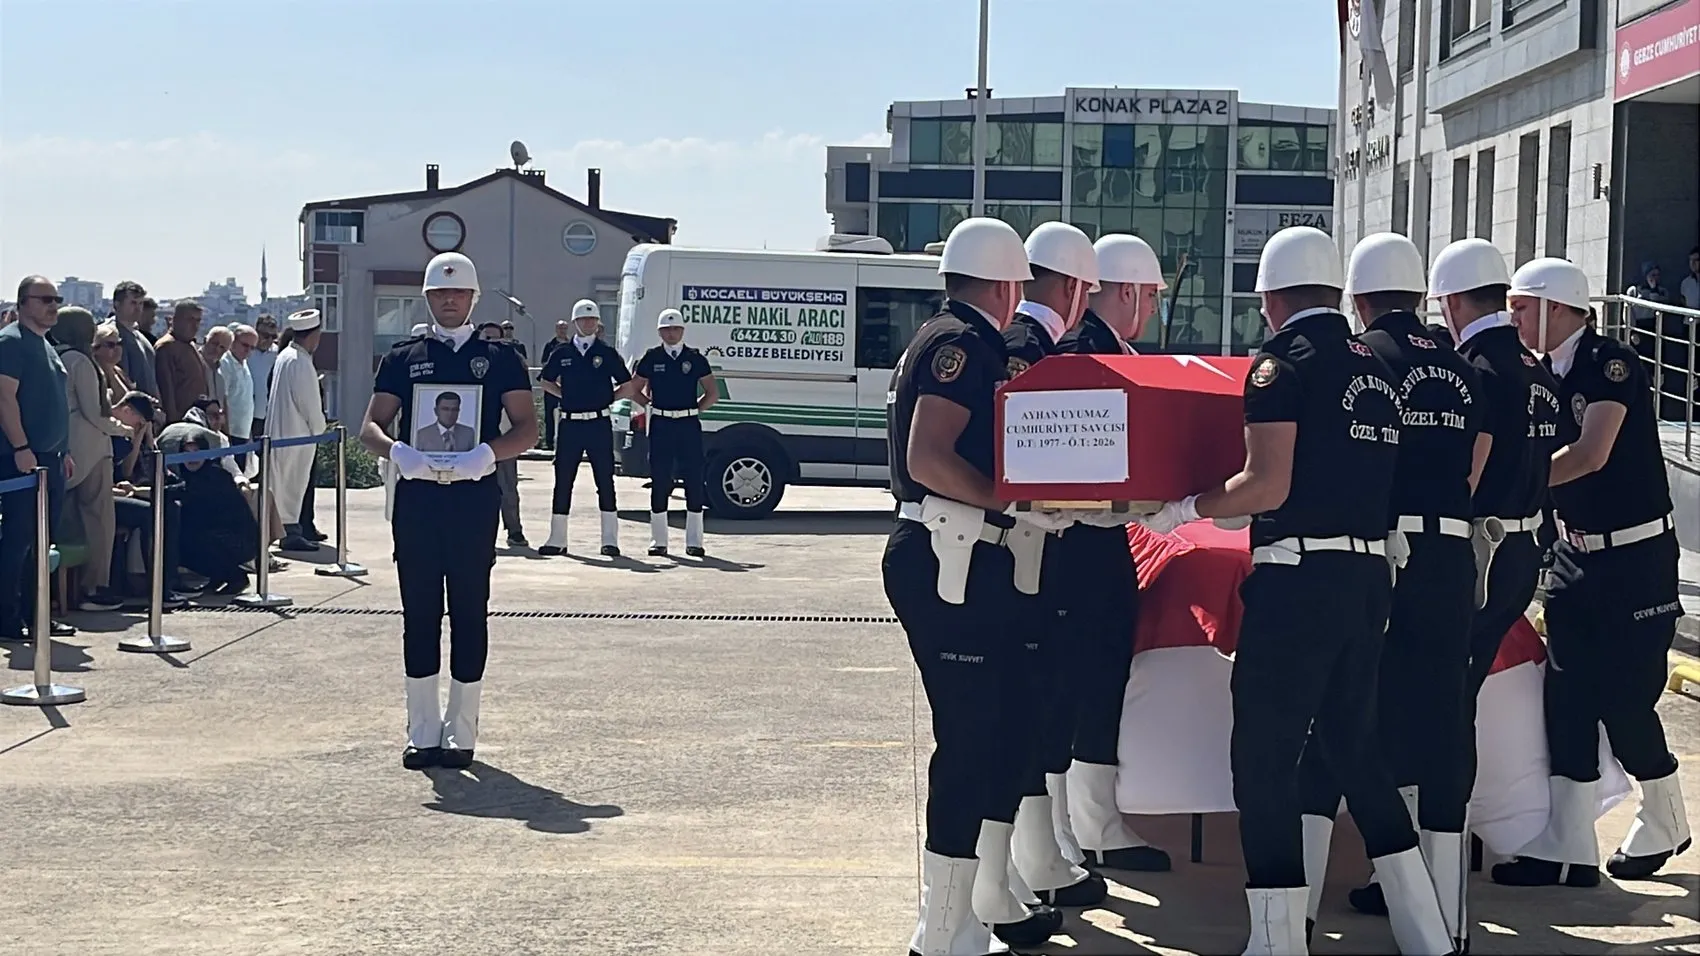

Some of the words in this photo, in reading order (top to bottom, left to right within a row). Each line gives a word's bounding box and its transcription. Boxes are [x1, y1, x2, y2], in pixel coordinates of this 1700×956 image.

[1075, 98, 1142, 113] KONAK
[1149, 98, 1213, 114] PLAZA
[1215, 100, 1228, 115] 2
[1278, 212, 1326, 228] FEZA
[679, 304, 742, 324] CENAZE
[797, 309, 845, 328] ARACI
[737, 329, 760, 342] 642
[762, 331, 778, 342] 04
[780, 331, 796, 343] 30
[822, 333, 844, 346] 188
[726, 347, 769, 359] GEBZE
[771, 348, 844, 362] BELEDİYESİ
[1342, 375, 1367, 412] ÇEVİK
[1427, 365, 1473, 405] KUVVET
[1021, 410, 1059, 420] AYHAN
[1060, 409, 1110, 419] UYUMAZ
[1402, 407, 1438, 425] ÖZEL
[1441, 409, 1465, 430] TİM
[1006, 423, 1078, 434] CUMHURİYET
[1080, 423, 1125, 433] SAVCISI
[1350, 420, 1378, 441] ÖZEL
[1381, 423, 1400, 445] TİM
[1040, 439, 1060, 448] 1977
[1068, 436, 1090, 447] Ö.T:
[1093, 438, 1115, 447] 2026
